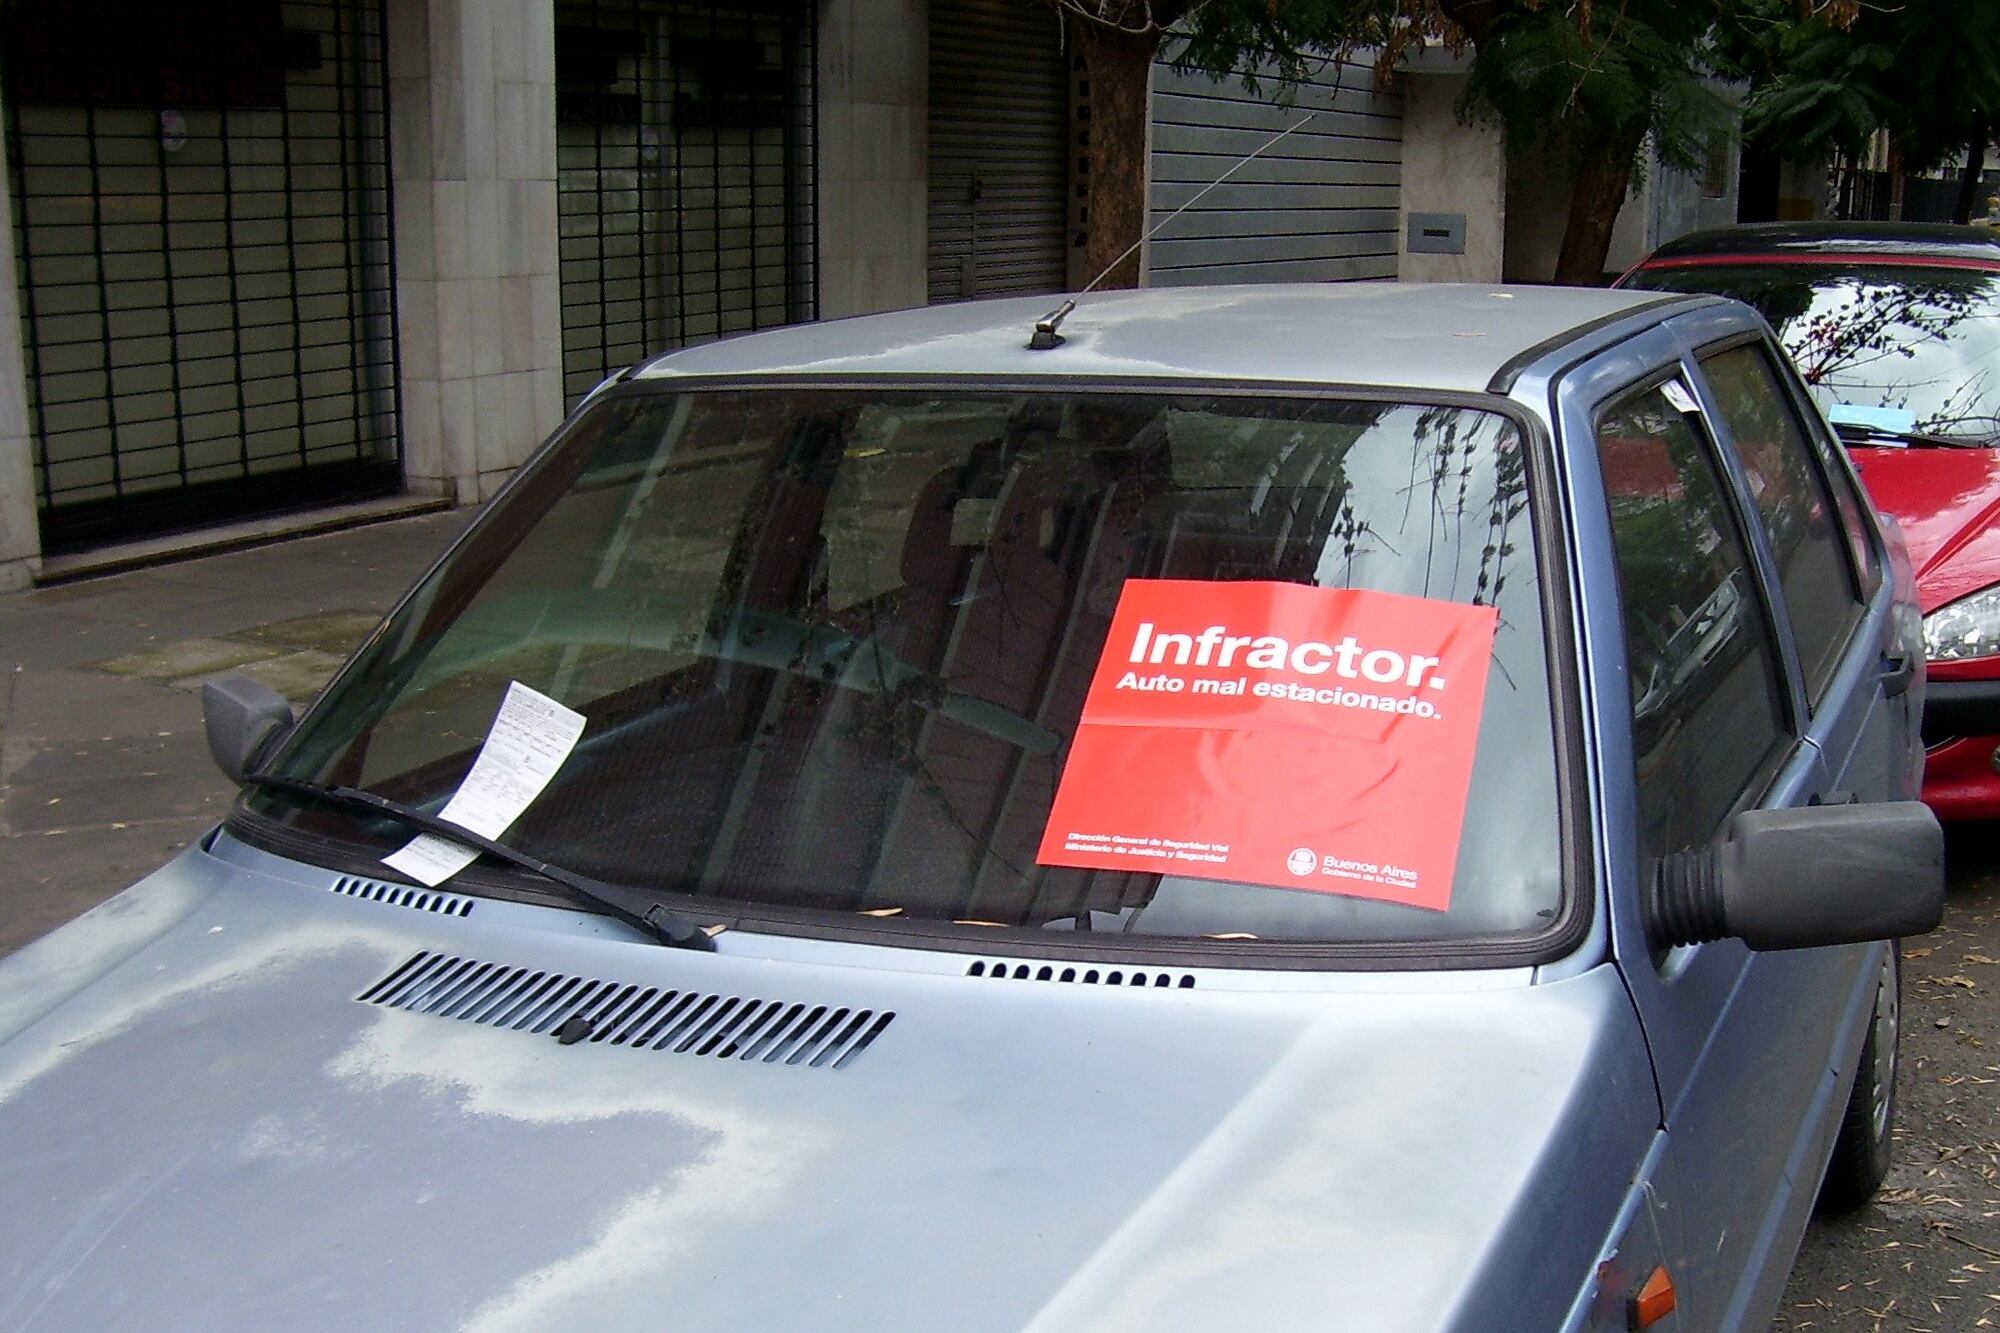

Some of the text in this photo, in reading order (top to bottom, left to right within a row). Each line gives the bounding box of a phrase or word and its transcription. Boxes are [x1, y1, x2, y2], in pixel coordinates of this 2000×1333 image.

[1127, 623, 1446, 690] Infractor.
[1115, 672, 1442, 719] Auto mal estacionado.
[1064, 842, 1228, 863] Ministerio de Justicia y Seguridad
[1112, 836, 1148, 846] General
[1149, 838, 1162, 846] de
[1162, 840, 1210, 852] Seguridad
[1321, 867, 1362, 879] Gobierno
[1385, 877, 1417, 889] Ciudad
[1323, 855, 1418, 881] Buenos Aires
